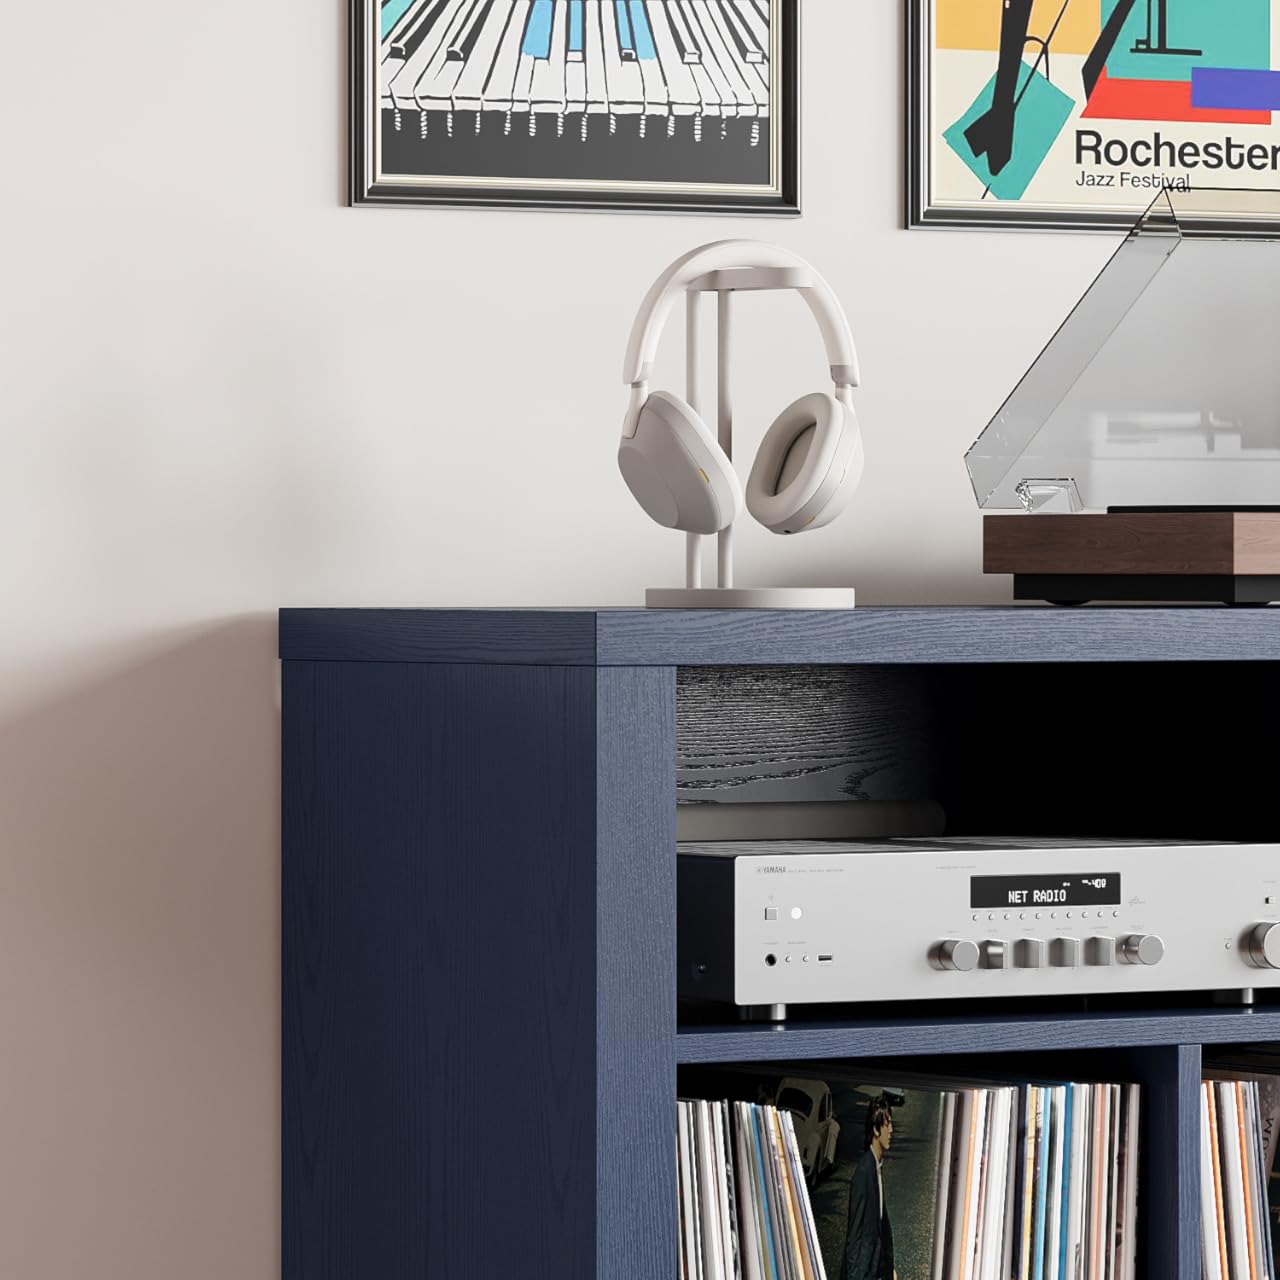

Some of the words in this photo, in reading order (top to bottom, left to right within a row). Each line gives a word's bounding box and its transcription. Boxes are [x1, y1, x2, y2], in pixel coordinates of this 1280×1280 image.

[1076, 171, 1115, 187] Jazz
[1120, 172, 1191, 193] Festival
[763, 866, 786, 874] YAMAHA
[1008, 890, 1028, 903] NET
[1033, 889, 1067, 903] RADIO
